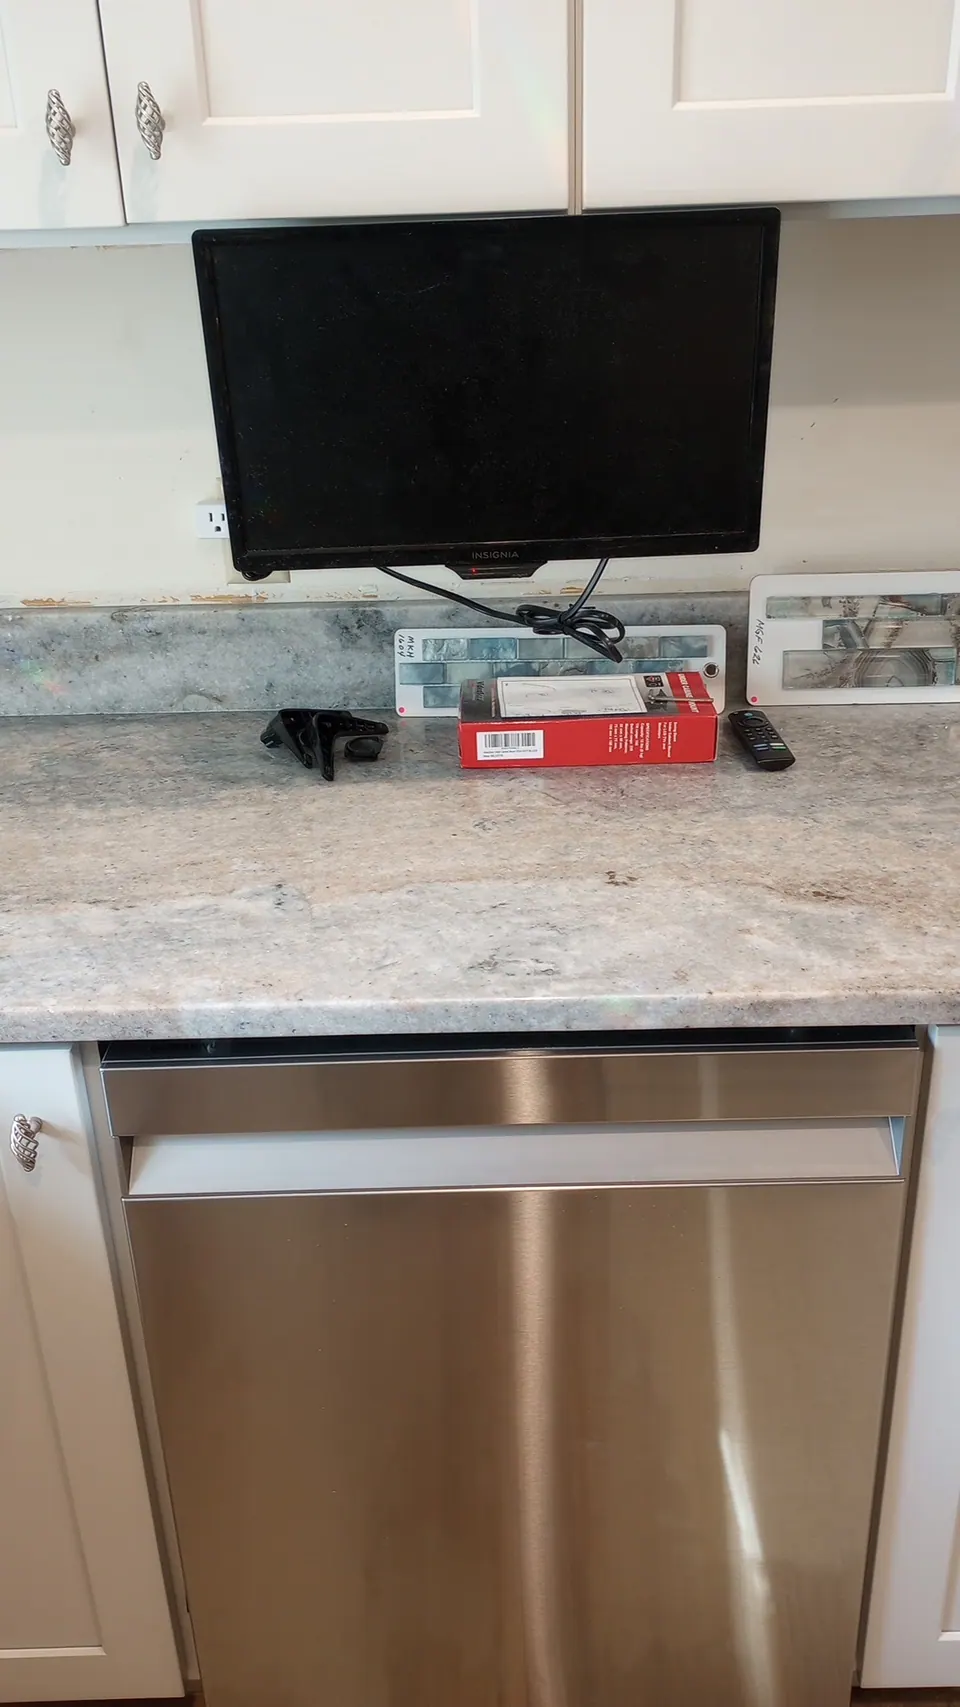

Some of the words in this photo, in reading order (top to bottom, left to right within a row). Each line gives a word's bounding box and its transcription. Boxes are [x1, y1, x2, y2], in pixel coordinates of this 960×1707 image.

[471, 551, 520, 560] INSIGNIA
[755, 619, 765, 644] MGF
[406, 636, 414, 658] MKH
